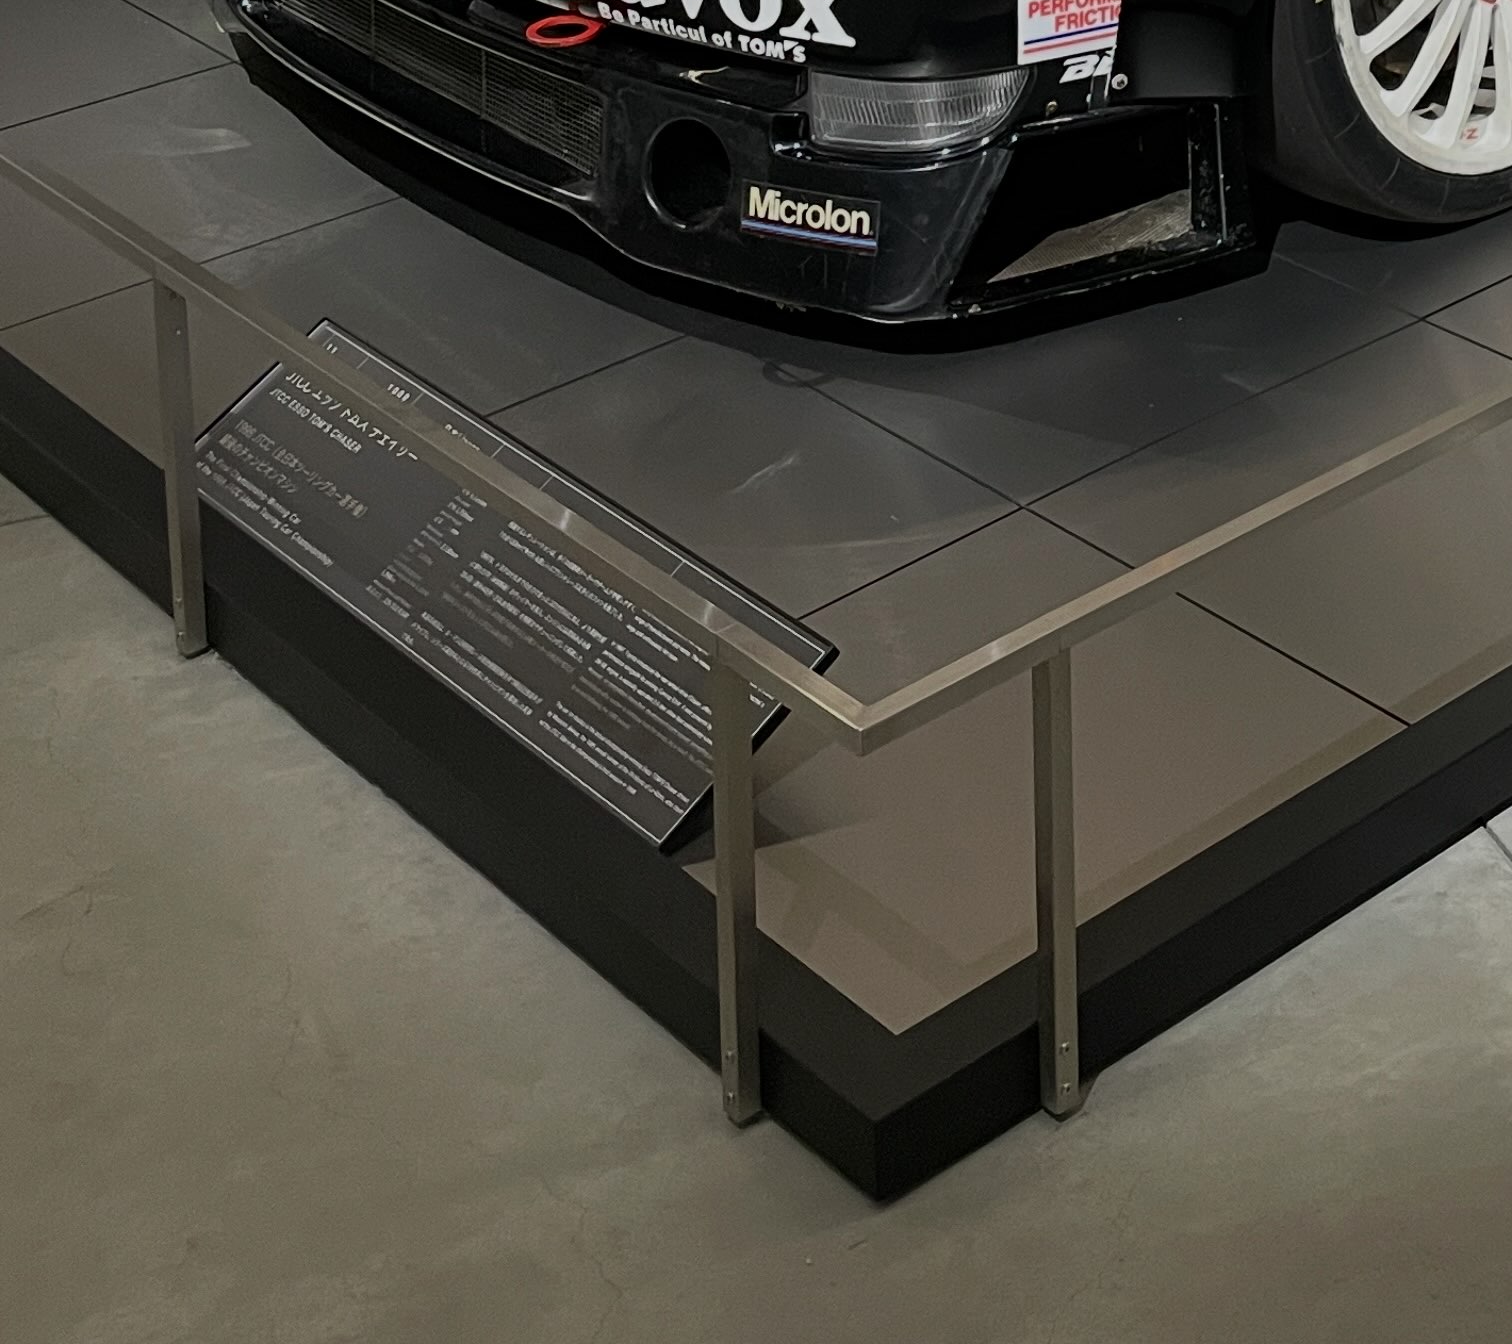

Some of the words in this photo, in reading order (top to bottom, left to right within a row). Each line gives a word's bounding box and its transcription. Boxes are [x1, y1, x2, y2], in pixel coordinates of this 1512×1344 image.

[597, 0, 625, 23] Be
[627, 8, 708, 44] Particul
[711, 30, 734, 50] of
[738, 34, 807, 63] TOM'S
[748, 185, 872, 237] Microlon
